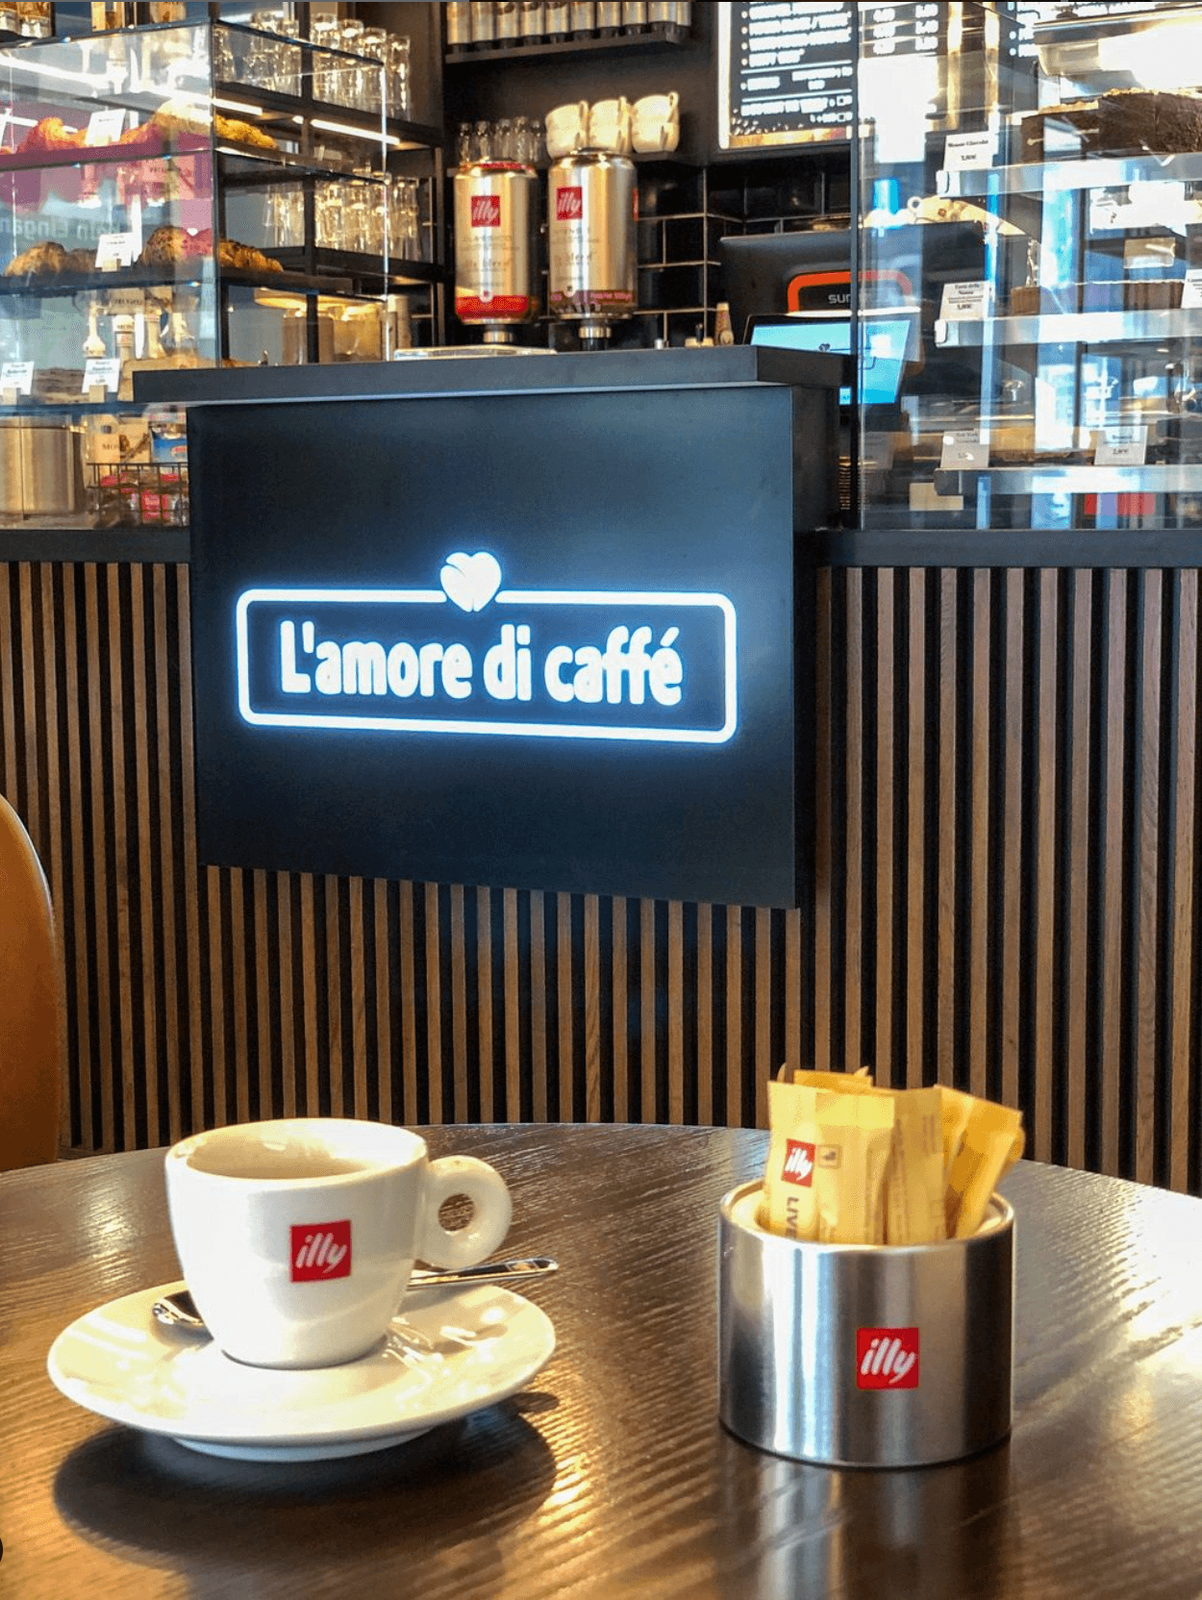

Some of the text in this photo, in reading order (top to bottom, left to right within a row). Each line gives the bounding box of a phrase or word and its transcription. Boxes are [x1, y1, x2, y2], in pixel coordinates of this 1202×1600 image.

[472, 199, 499, 224] illy
[558, 191, 581, 217] illy
[279, 619, 684, 706] L'amore di caffé
[784, 1147, 813, 1182] illy
[294, 1231, 348, 1274] illy
[860, 1335, 916, 1385] illy
